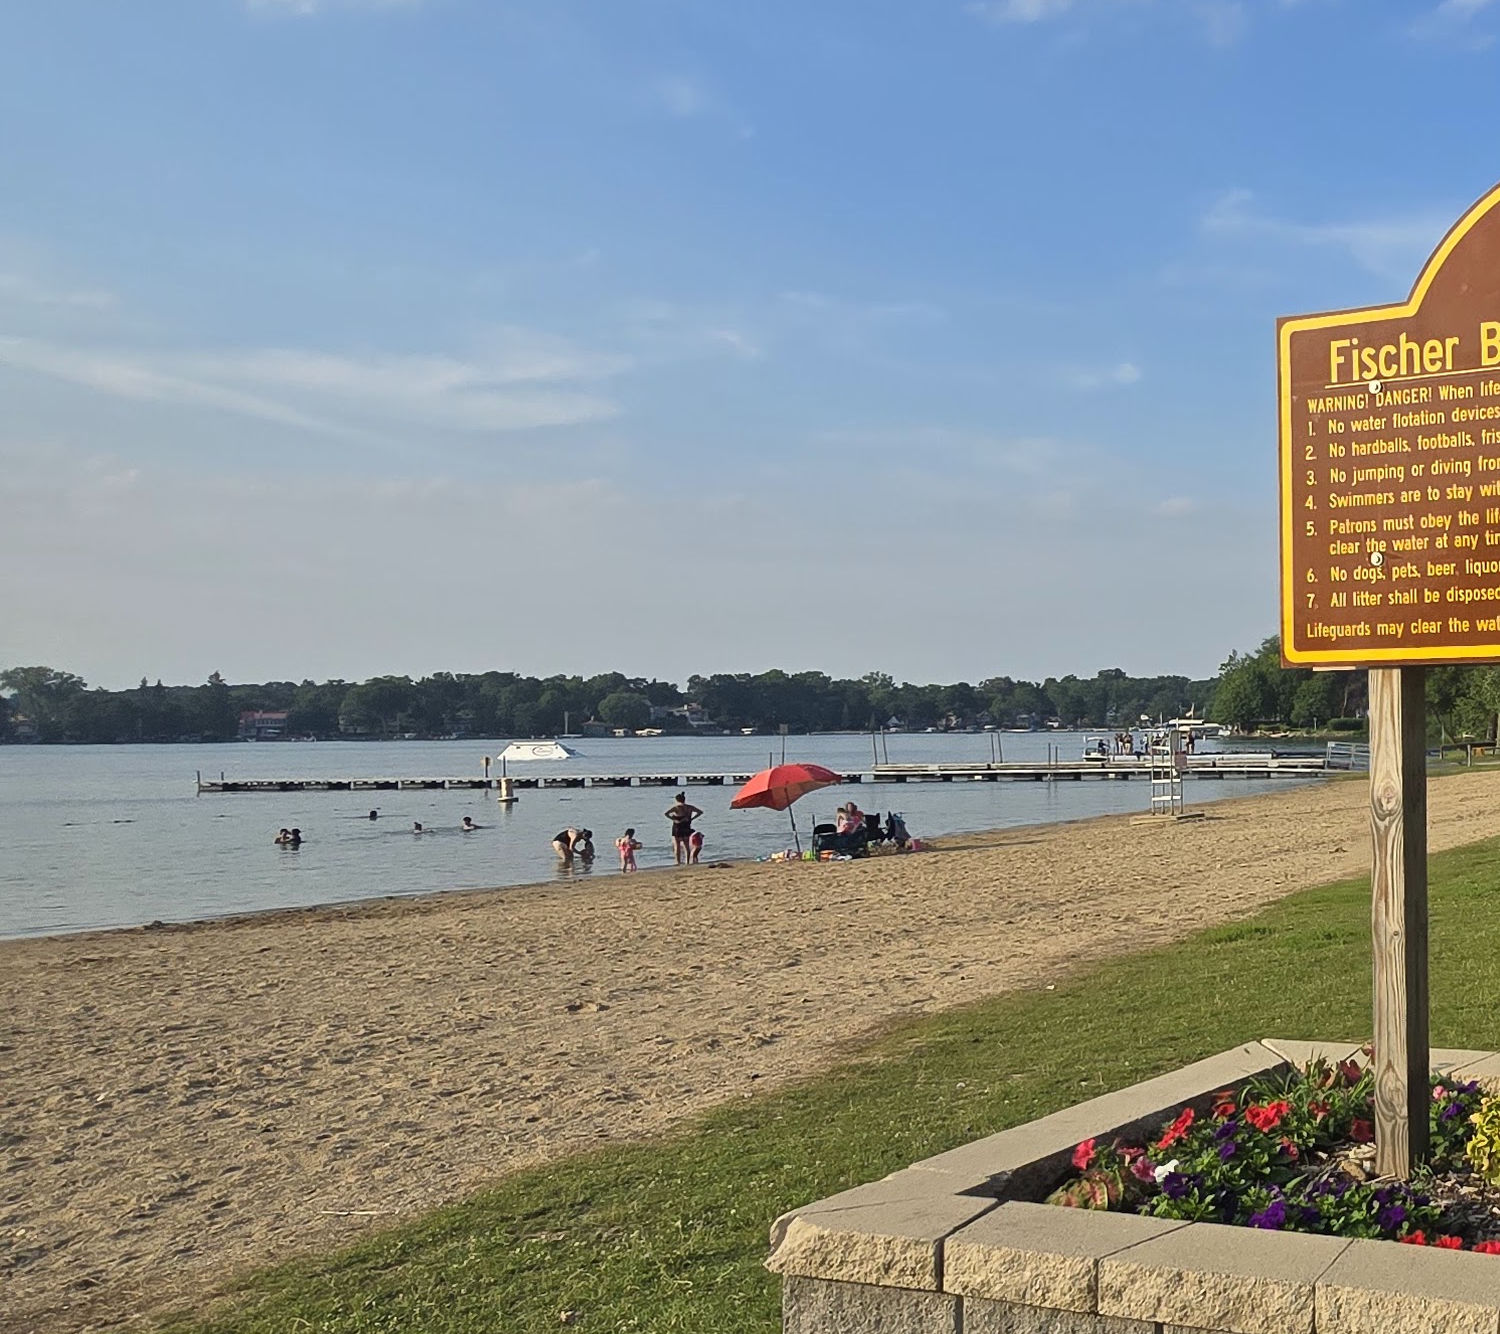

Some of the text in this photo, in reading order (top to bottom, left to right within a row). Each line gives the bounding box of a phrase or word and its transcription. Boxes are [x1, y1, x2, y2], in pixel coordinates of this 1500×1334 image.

[1331, 332, 1459, 383] Fischer
[1308, 394, 1368, 413] WARNING!
[1376, 387, 1431, 407] DANGER!
[1439, 385, 1473, 400] When
[1309, 421, 1316, 436] 1.
[1329, 419, 1344, 434] No
[1351, 416, 1386, 432] water
[1393, 410, 1445, 428] flotation
[1452, 405, 1500, 422] devices
[1306, 446, 1317, 460] 2.
[1329, 443, 1345, 457] No
[1352, 437, 1411, 456] hardballs,
[1417, 432, 1475, 450] footballs,
[1307, 471, 1317, 485] 3.
[1331, 468, 1346, 483] No
[1352, 464, 1404, 486] jumping
[1411, 465, 1424, 476] or
[1431, 458, 1471, 477] diving
[1305, 495, 1317, 509] 4.
[1329, 492, 1394, 508] Swimmers
[1401, 490, 1420, 502] are
[1427, 486, 1440, 500] to
[1446, 484, 1473, 501] stay
[1307, 521, 1317, 536] 5.
[1330, 519, 1376, 534] Patrons
[1383, 514, 1414, 531] must
[1420, 513, 1452, 530] obey
[1458, 511, 1479, 525] the
[1330, 540, 1360, 555] clear
[1366, 538, 1386, 552] the
[1392, 535, 1429, 551] water
[1435, 533, 1448, 548] at
[1454, 534, 1478, 550] any
[1307, 568, 1318, 582] 6.
[1331, 566, 1347, 581] No
[1354, 565, 1385, 584] dogs,
[1392, 562, 1420, 581] pets,
[1331, 592, 1346, 607] All
[1353, 591, 1382, 606] litter
[1388, 588, 1417, 605] shall
[1424, 588, 1440, 603] be
[1307, 621, 1370, 641] Lifeguards
[1377, 623, 1404, 638] may
[1411, 619, 1442, 634] clear
[1448, 618, 1470, 632] the
